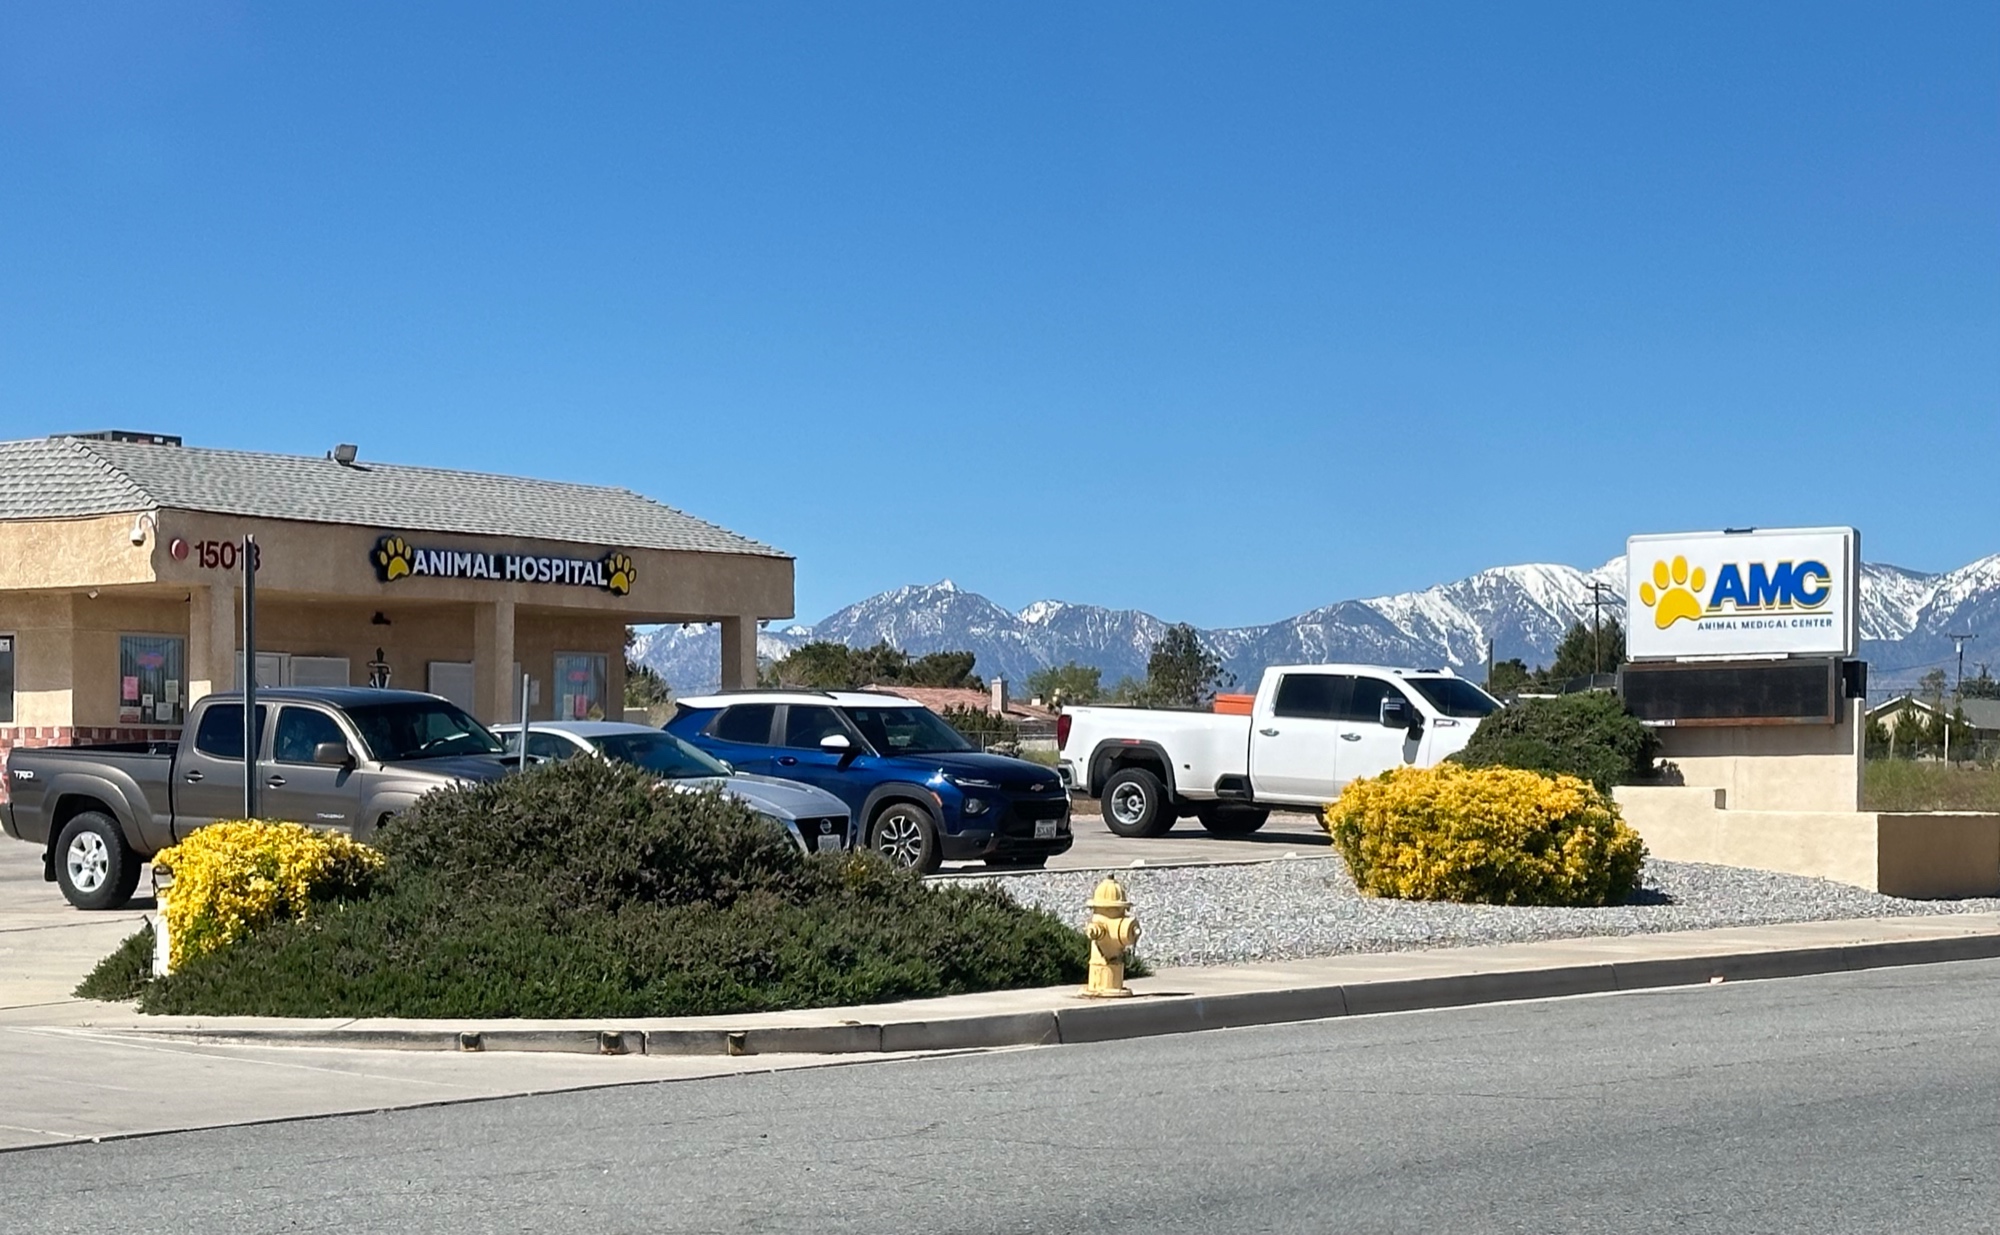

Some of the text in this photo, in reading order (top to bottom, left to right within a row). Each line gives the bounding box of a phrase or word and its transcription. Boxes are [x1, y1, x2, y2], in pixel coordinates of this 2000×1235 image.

[413, 549, 608, 586] ANIMAL HOSPITAL
[1706, 560, 1832, 612] AMC
[1697, 618, 1833, 631] ANIMAL MEDICAL CENTER
[13, 769, 35, 780] TRD
